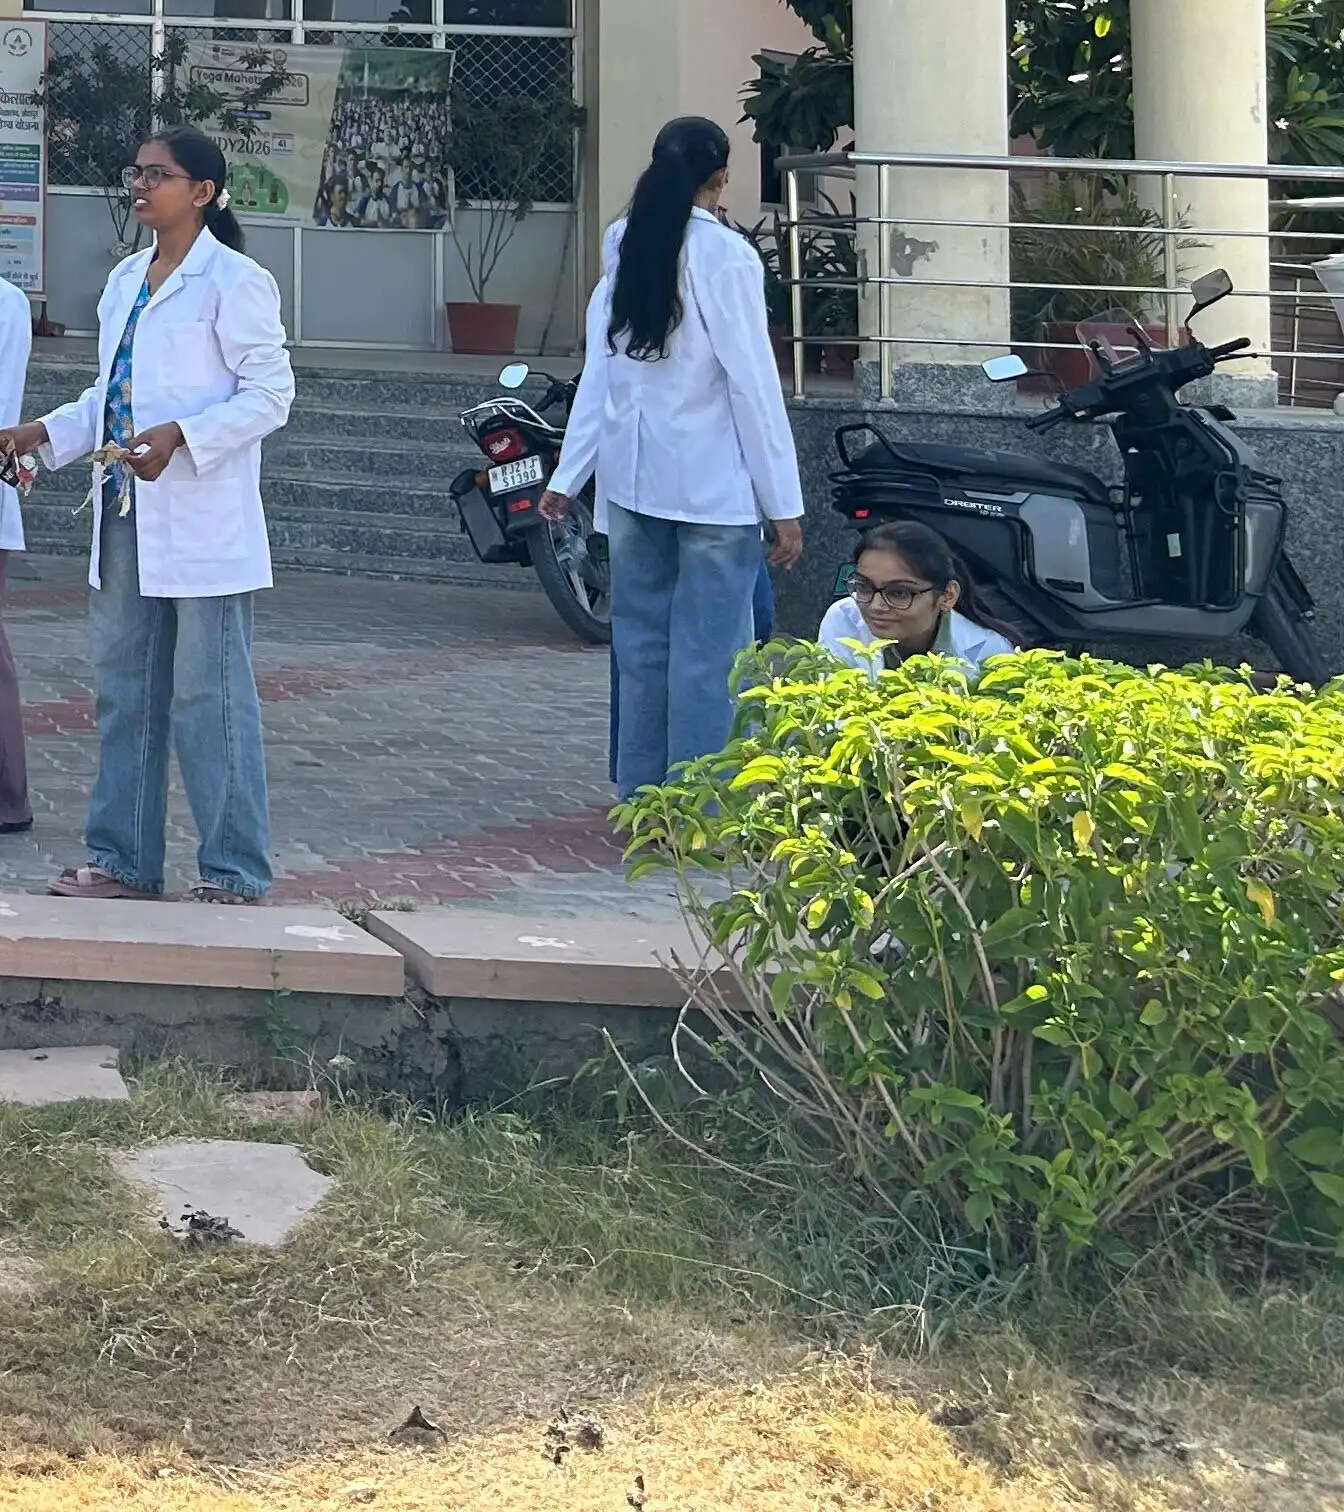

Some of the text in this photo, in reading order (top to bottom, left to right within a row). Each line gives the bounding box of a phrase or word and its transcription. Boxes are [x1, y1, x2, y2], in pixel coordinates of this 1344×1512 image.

[197, 70, 222, 84] Yoga
[502, 469, 536, 487] S1390
[944, 499, 1002, 512] ORBITER
